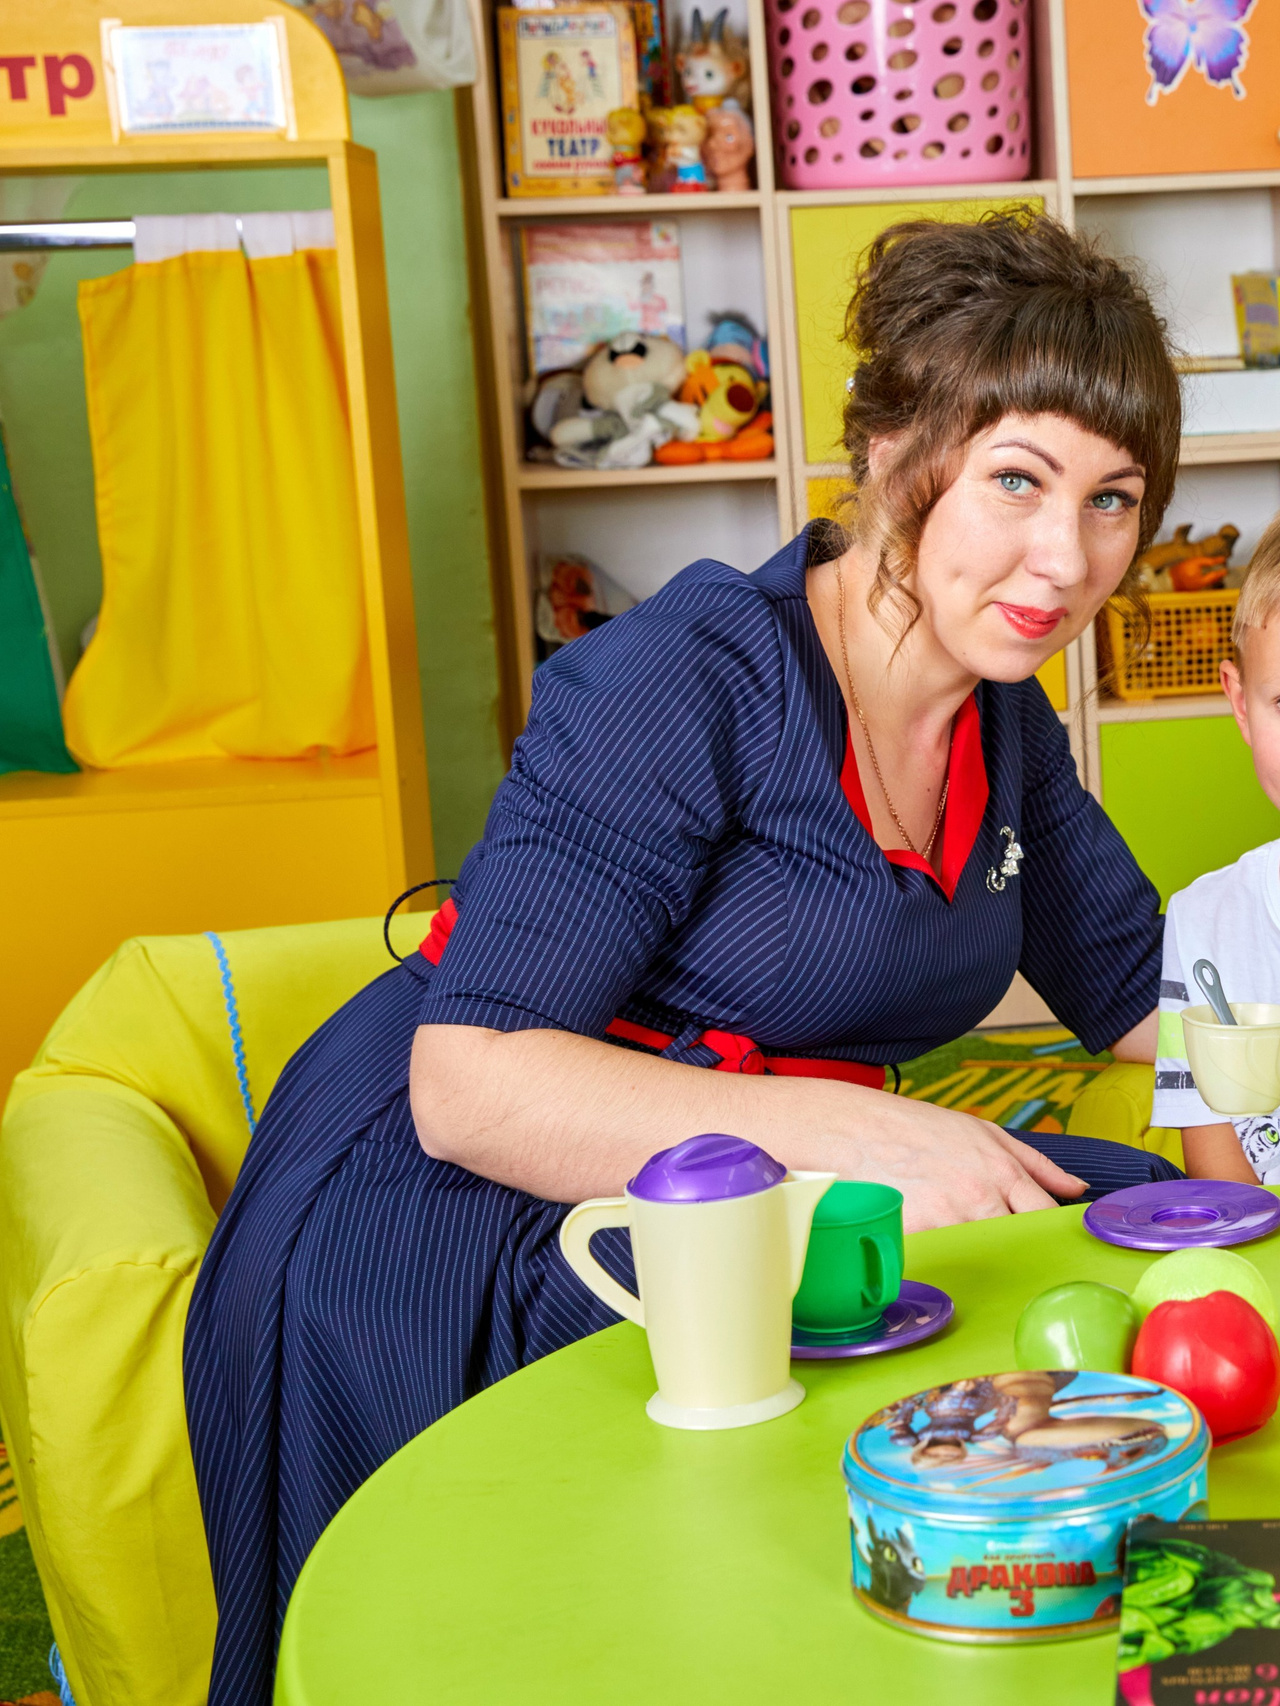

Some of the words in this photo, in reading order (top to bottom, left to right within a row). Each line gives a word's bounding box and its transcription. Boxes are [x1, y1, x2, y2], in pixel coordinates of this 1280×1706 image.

[532, 119, 607, 136] КУКОЛЬНЫ
[548, 138, 601, 157] ТЕАТР
[946, 1560, 1097, 1599] ДРАКОНА
[1009, 1589, 1036, 1618] 3
